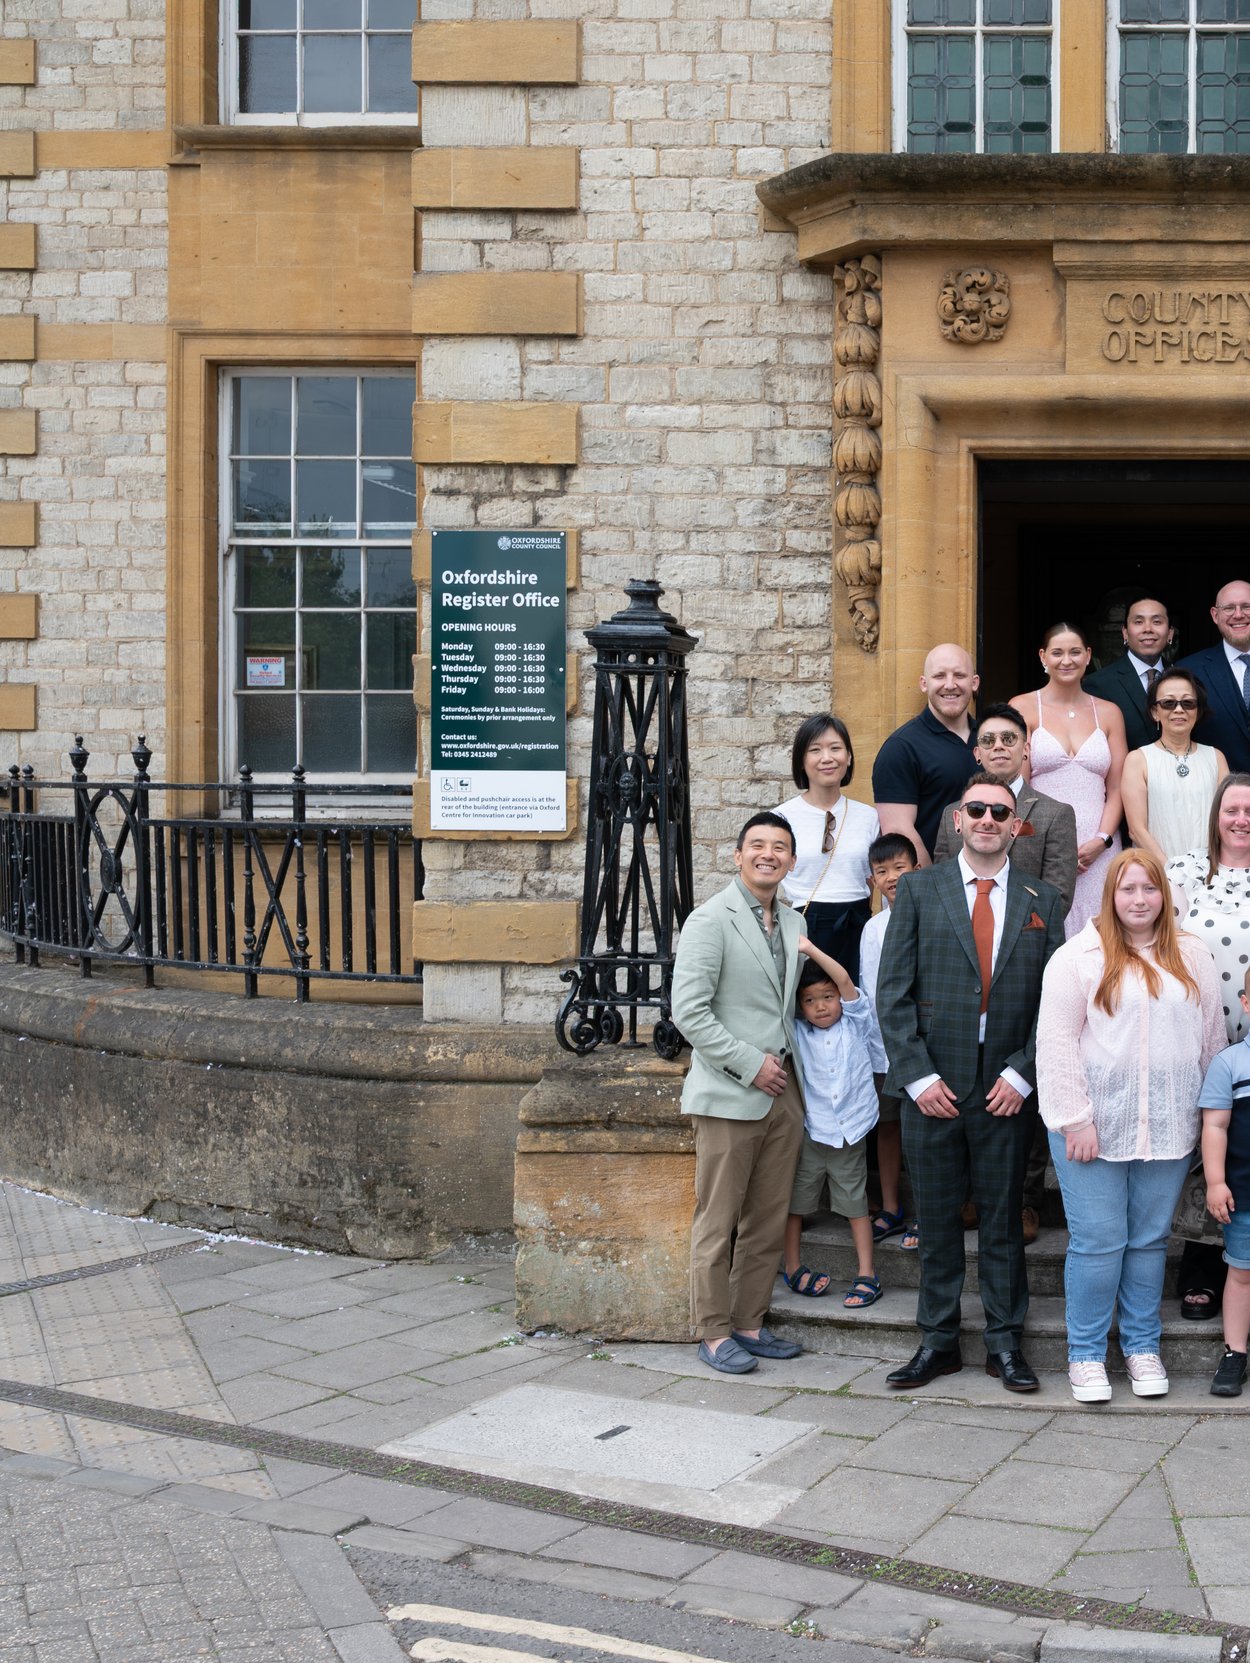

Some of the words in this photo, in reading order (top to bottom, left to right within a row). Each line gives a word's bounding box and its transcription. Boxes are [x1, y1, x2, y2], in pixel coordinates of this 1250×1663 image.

[442, 570, 537, 585] Oxfordshire
[442, 592, 509, 610] Register
[513, 592, 560, 607] Office
[441, 623, 482, 631] OPENING
[485, 623, 516, 631] HOURS
[441, 643, 473, 652] Monday
[441, 654, 474, 662] Tuesday
[441, 664, 487, 674] Wednesday
[441, 675, 479, 684] Thursday
[441, 686, 467, 695] Friday
